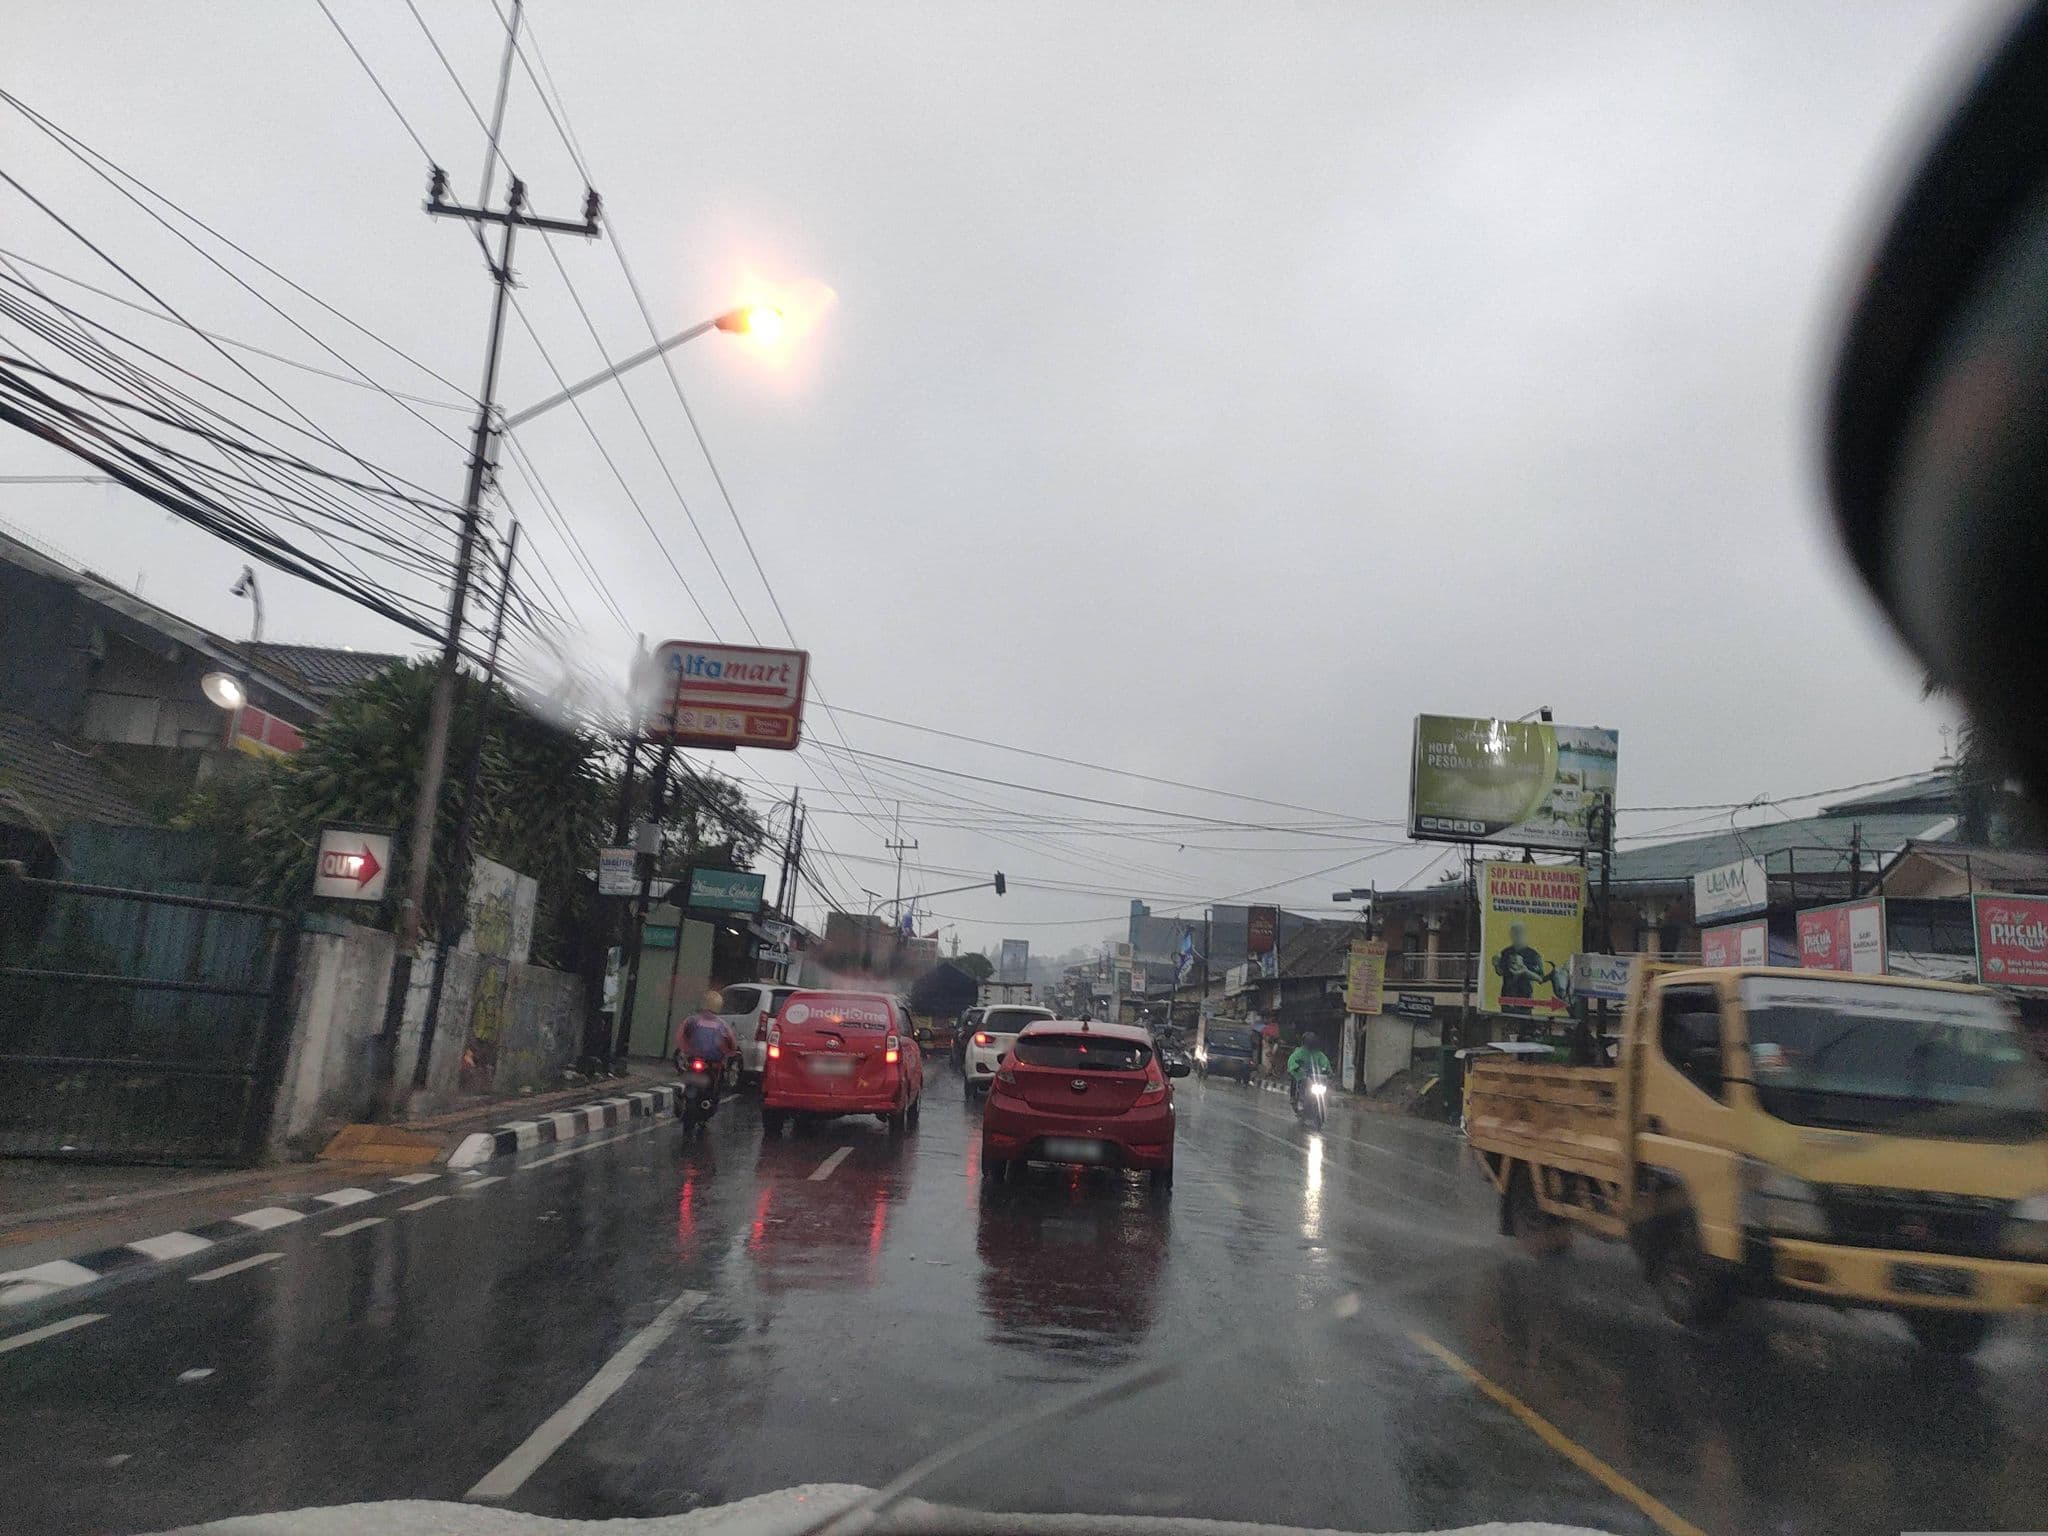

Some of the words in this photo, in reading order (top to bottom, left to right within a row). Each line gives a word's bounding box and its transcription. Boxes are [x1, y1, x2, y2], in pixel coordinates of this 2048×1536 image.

[666, 652, 791, 683] Alfamart
[1428, 742, 1458, 755] HOTEL
[1428, 754, 1473, 769] PESONA
[324, 855, 361, 877] OUT
[1491, 880, 1526, 897] KANG
[1530, 883, 1580, 901] MAMAN
[810, 1008, 887, 1022] IndiHome
